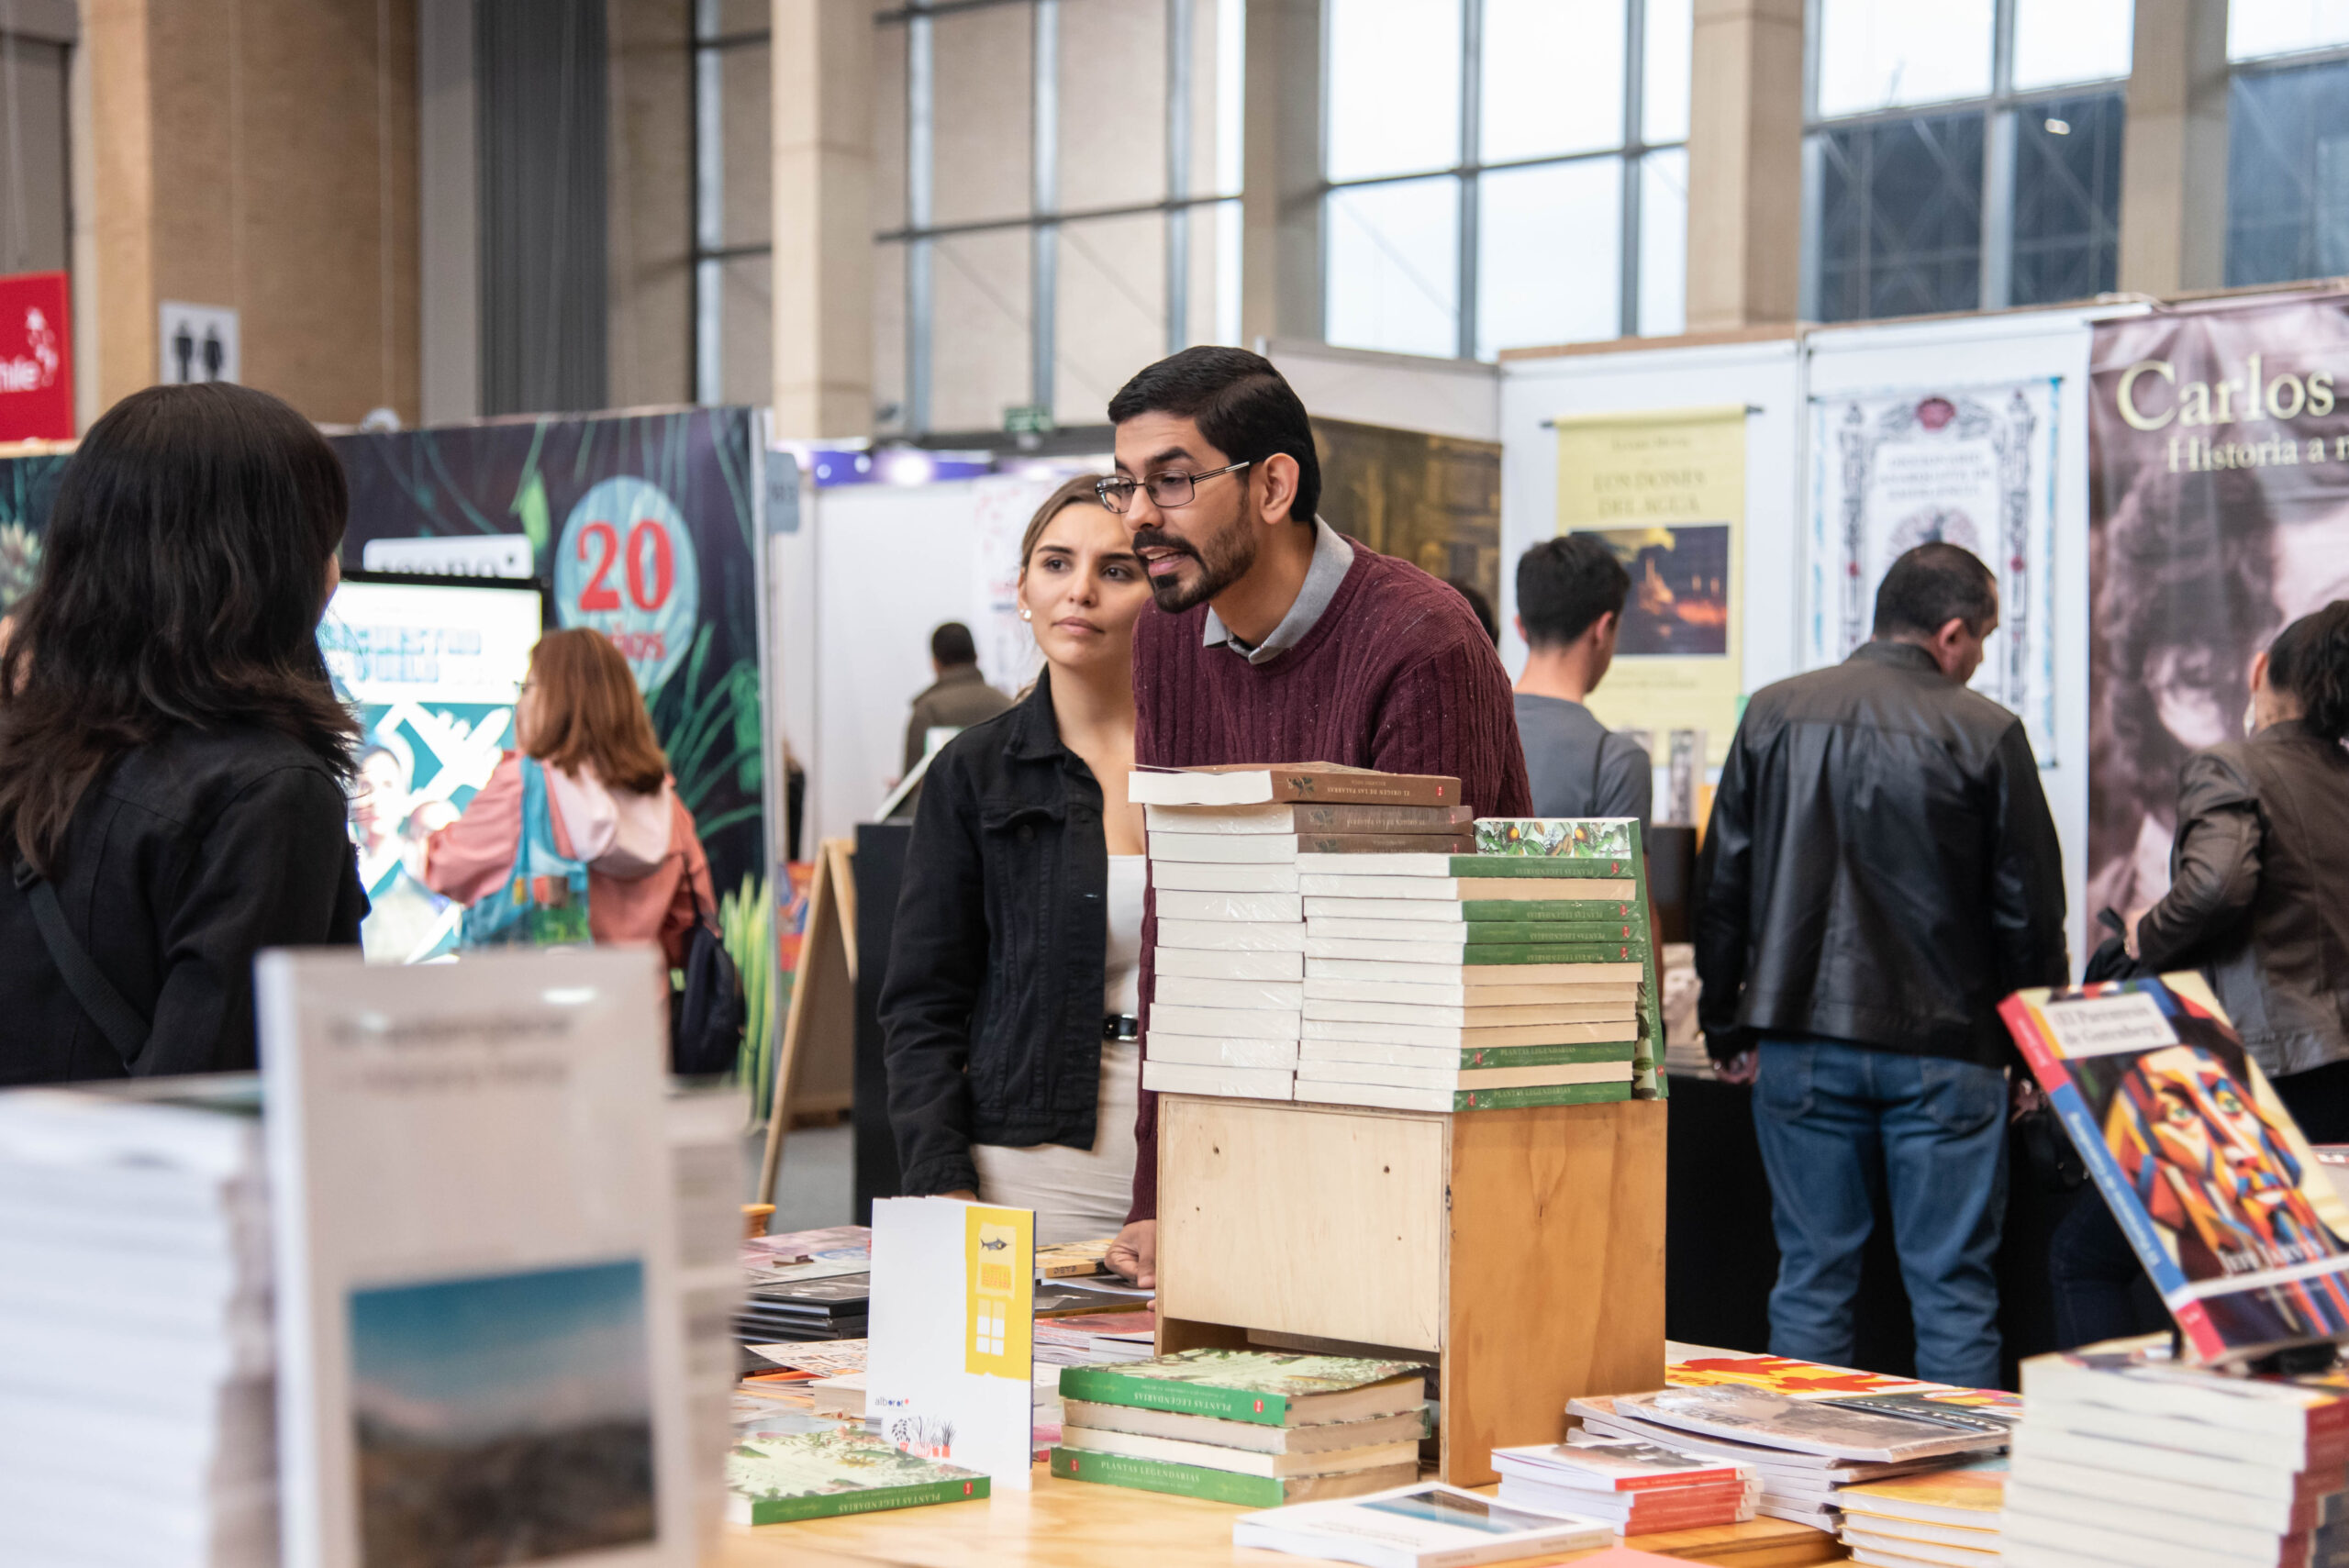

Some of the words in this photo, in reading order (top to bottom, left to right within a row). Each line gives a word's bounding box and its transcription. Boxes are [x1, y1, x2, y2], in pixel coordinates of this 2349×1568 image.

[2116, 351, 2335, 431] Carlos
[2167, 432, 2299, 473] Historia
[2307, 437, 2327, 463] a
[577, 518, 674, 612] 20
[612, 622, 666, 662] ños
[1379, 788, 1402, 796] ORIGEN
[1134, 1392, 1192, 1407] LEGENDARIAS
[1194, 1400, 1231, 1412] PLANTAS
[1100, 1461, 1138, 1475] PLANTAS
[1140, 1465, 1200, 1484] LEGENDARIAS
[838, 1497, 901, 1513] LEGENDARIAS
[903, 1493, 941, 1506] PLANTAS
